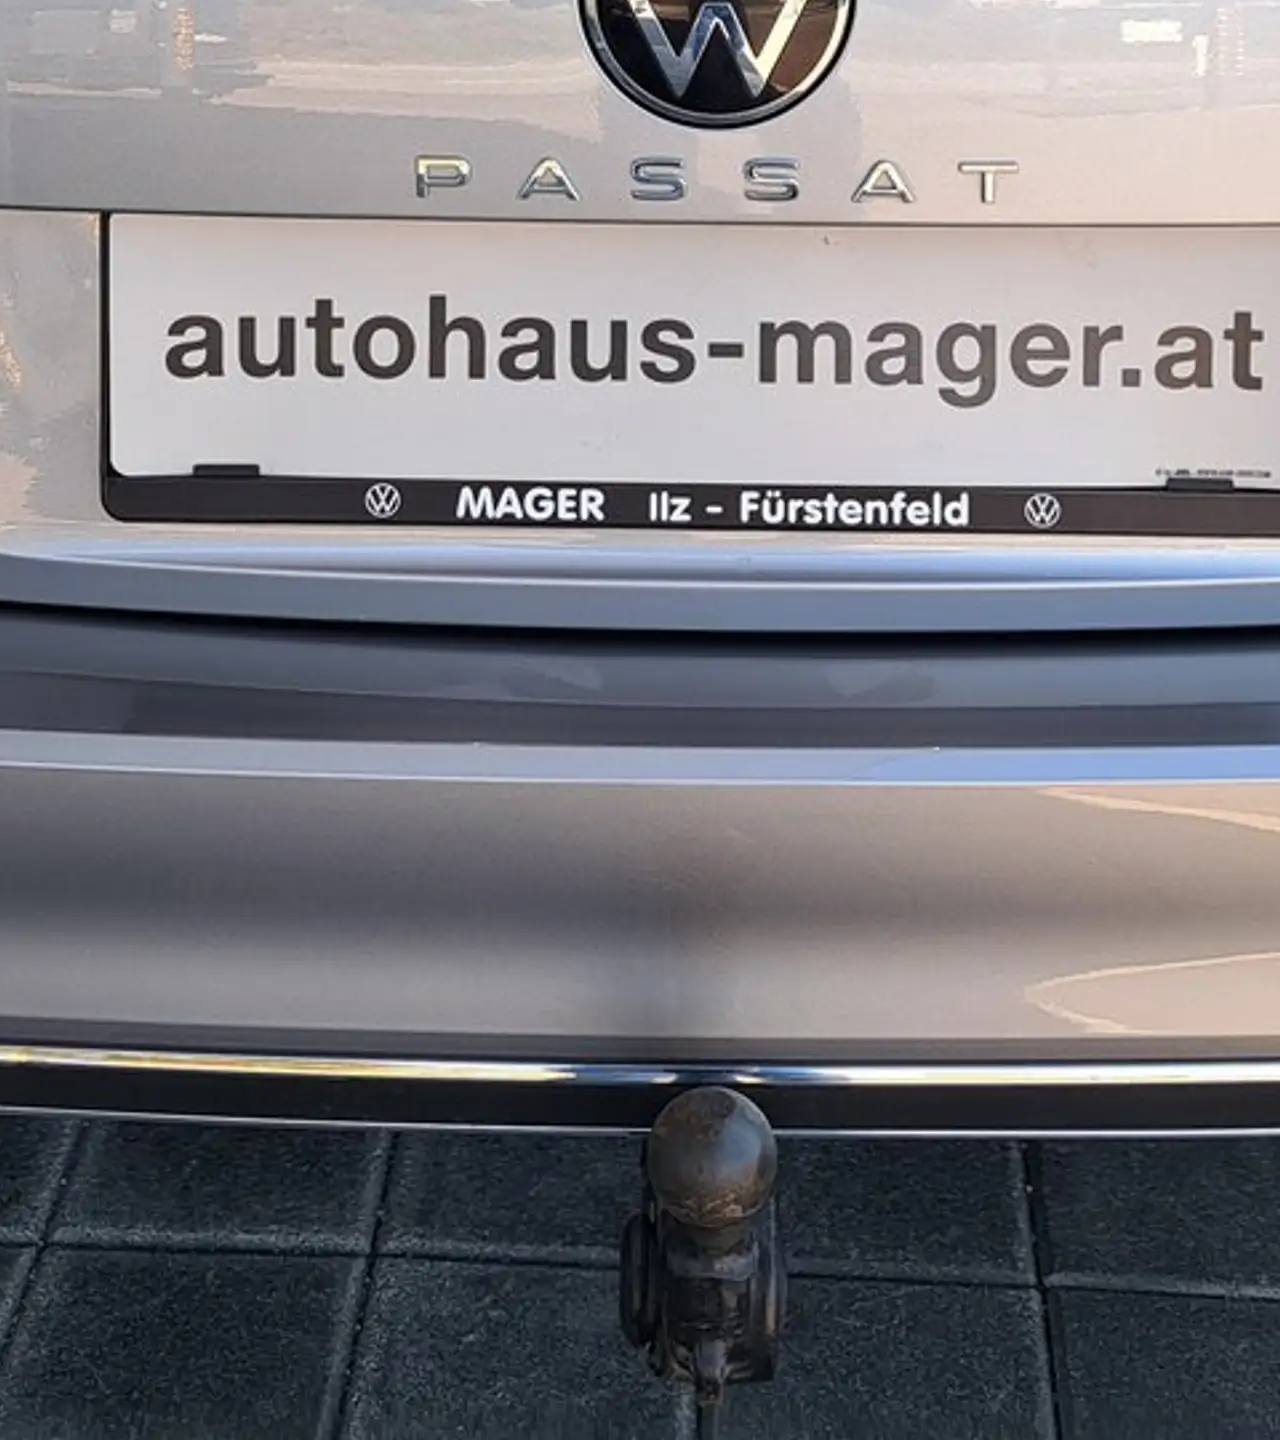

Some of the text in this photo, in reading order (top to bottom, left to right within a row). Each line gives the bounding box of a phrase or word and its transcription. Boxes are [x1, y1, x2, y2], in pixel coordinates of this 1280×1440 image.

[414, 154, 1020, 205] PASSAT
[165, 295, 1264, 408] autohaus-mager.at
[455, 485, 606, 522] MAGER
[649, 490, 693, 523] Ilz
[739, 489, 970, 527] Fürstenfeld
